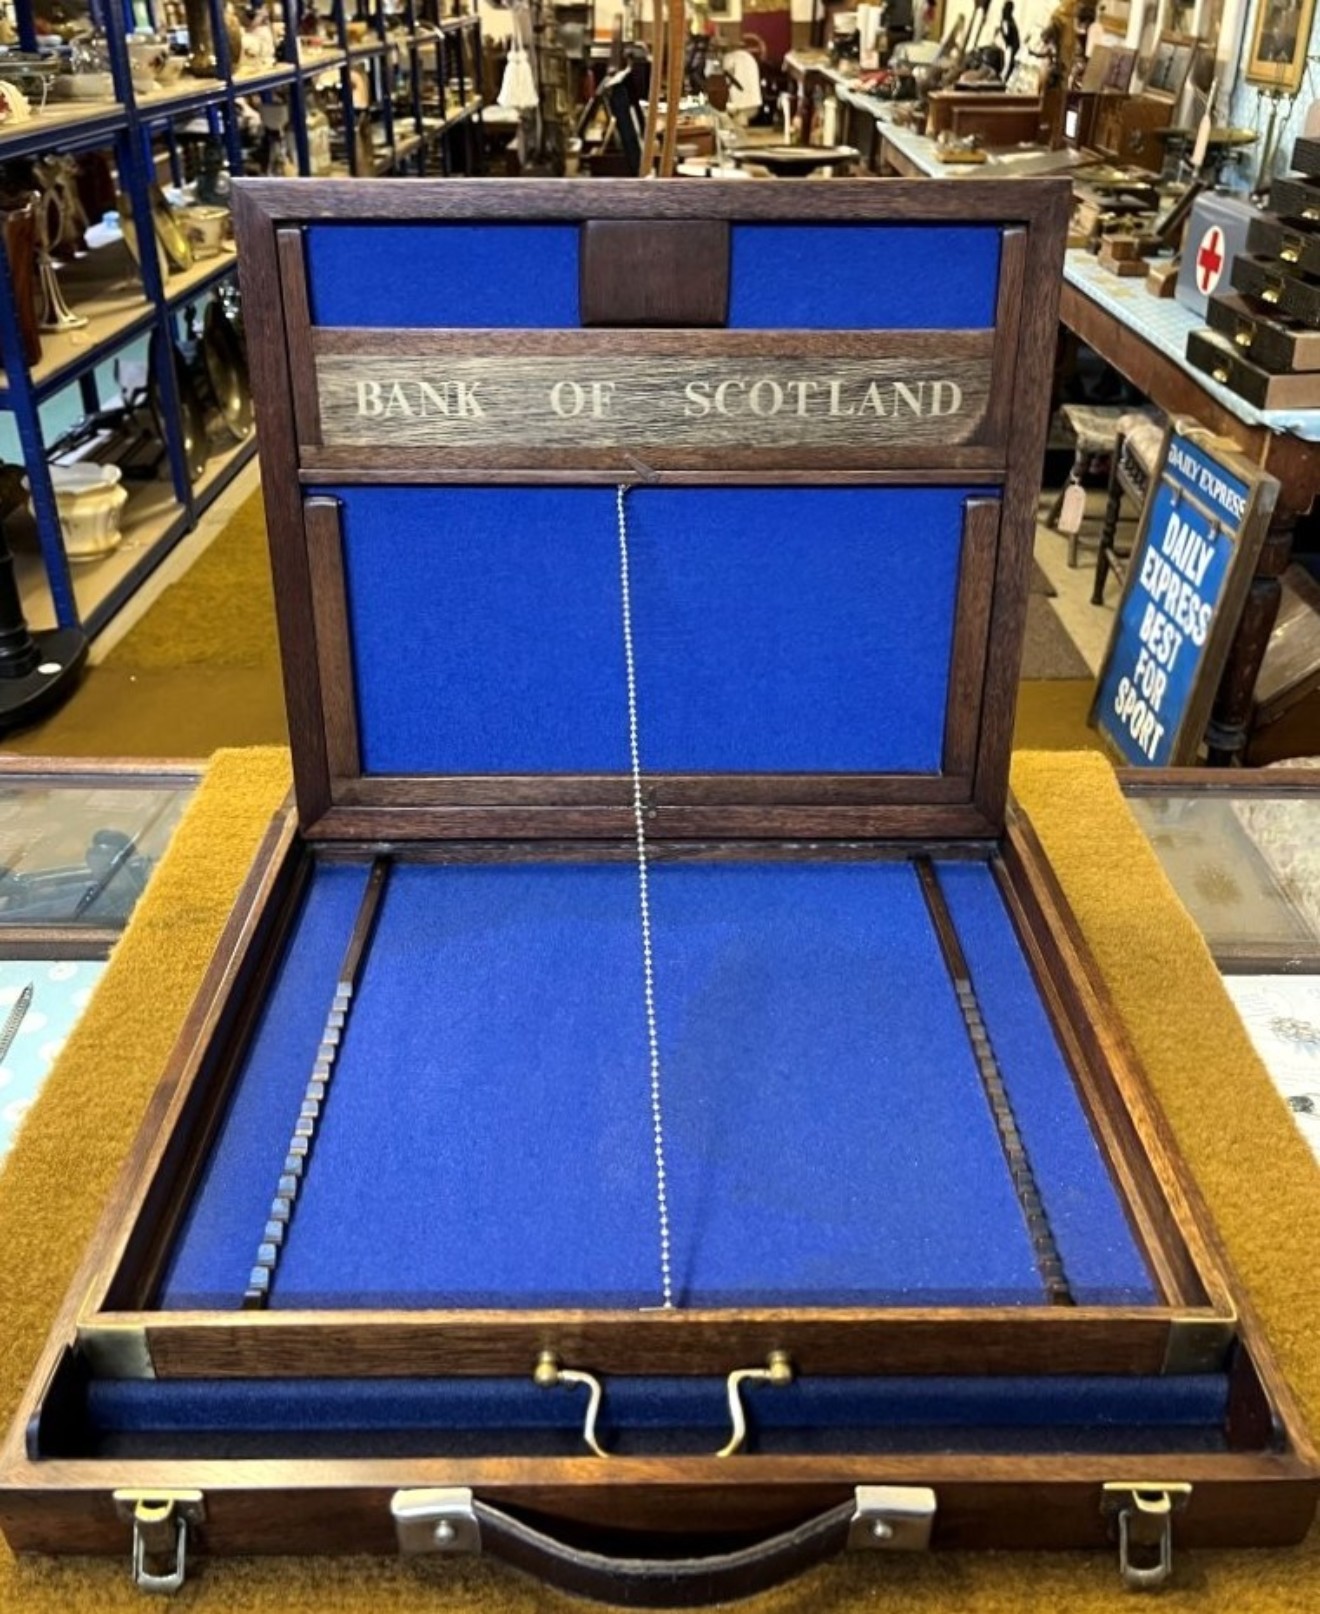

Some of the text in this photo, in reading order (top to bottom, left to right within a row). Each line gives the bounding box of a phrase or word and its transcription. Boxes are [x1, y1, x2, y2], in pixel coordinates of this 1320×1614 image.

[355, 378, 963, 420] BANK OF SCOTLAND
[1168, 443, 1247, 522] DAILY EXPRESS
[1161, 511, 1215, 587] DAILY
[1139, 545, 1212, 647] EXPRESS
[1139, 602, 1183, 673] BEST
[1114, 676, 1165, 761] SPORT
[1133, 649, 1167, 713] FOR
